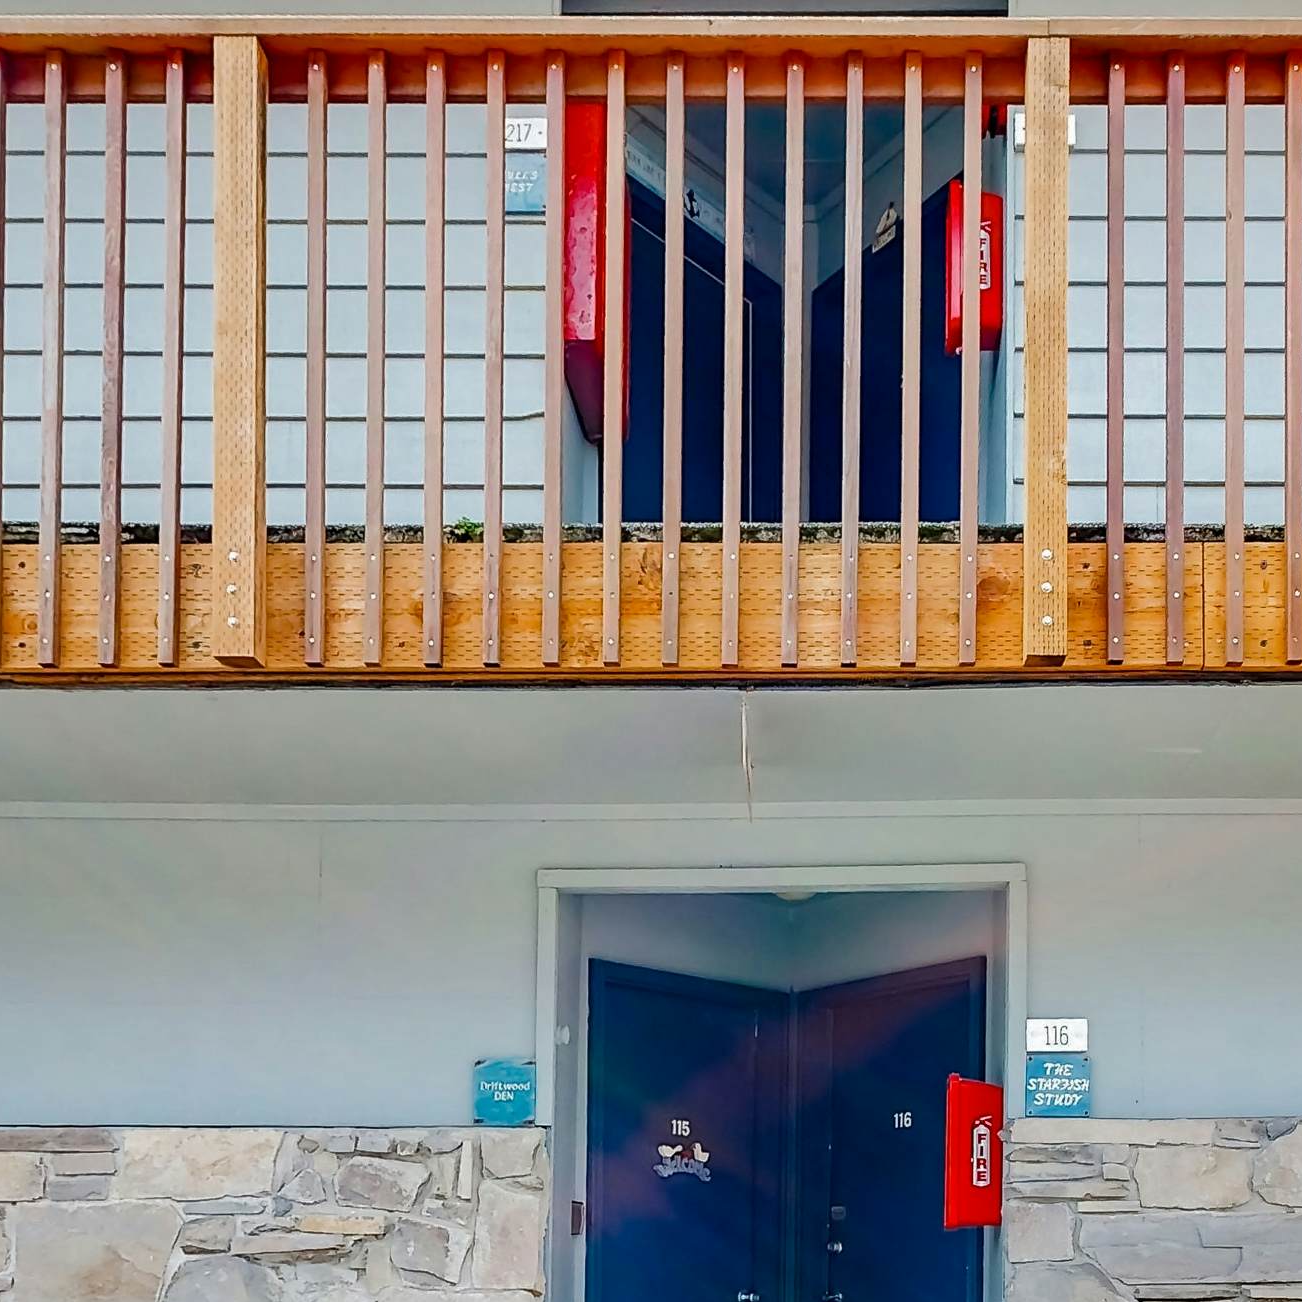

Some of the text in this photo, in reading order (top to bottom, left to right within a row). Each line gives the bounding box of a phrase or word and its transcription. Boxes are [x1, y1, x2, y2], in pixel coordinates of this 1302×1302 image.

[505, 123, 532, 142] 217
[979, 238, 988, 285] FIRE
[1044, 1025, 1069, 1046] 116
[1043, 1062, 1073, 1076] THE
[480, 1081, 531, 1091] Driftwood
[494, 1091, 514, 1101] DEN
[1033, 1093, 1083, 1106] STUDY
[671, 1119, 691, 1136] 115
[893, 1111, 912, 1129] 116
[976, 1133, 987, 1182] FIRE
